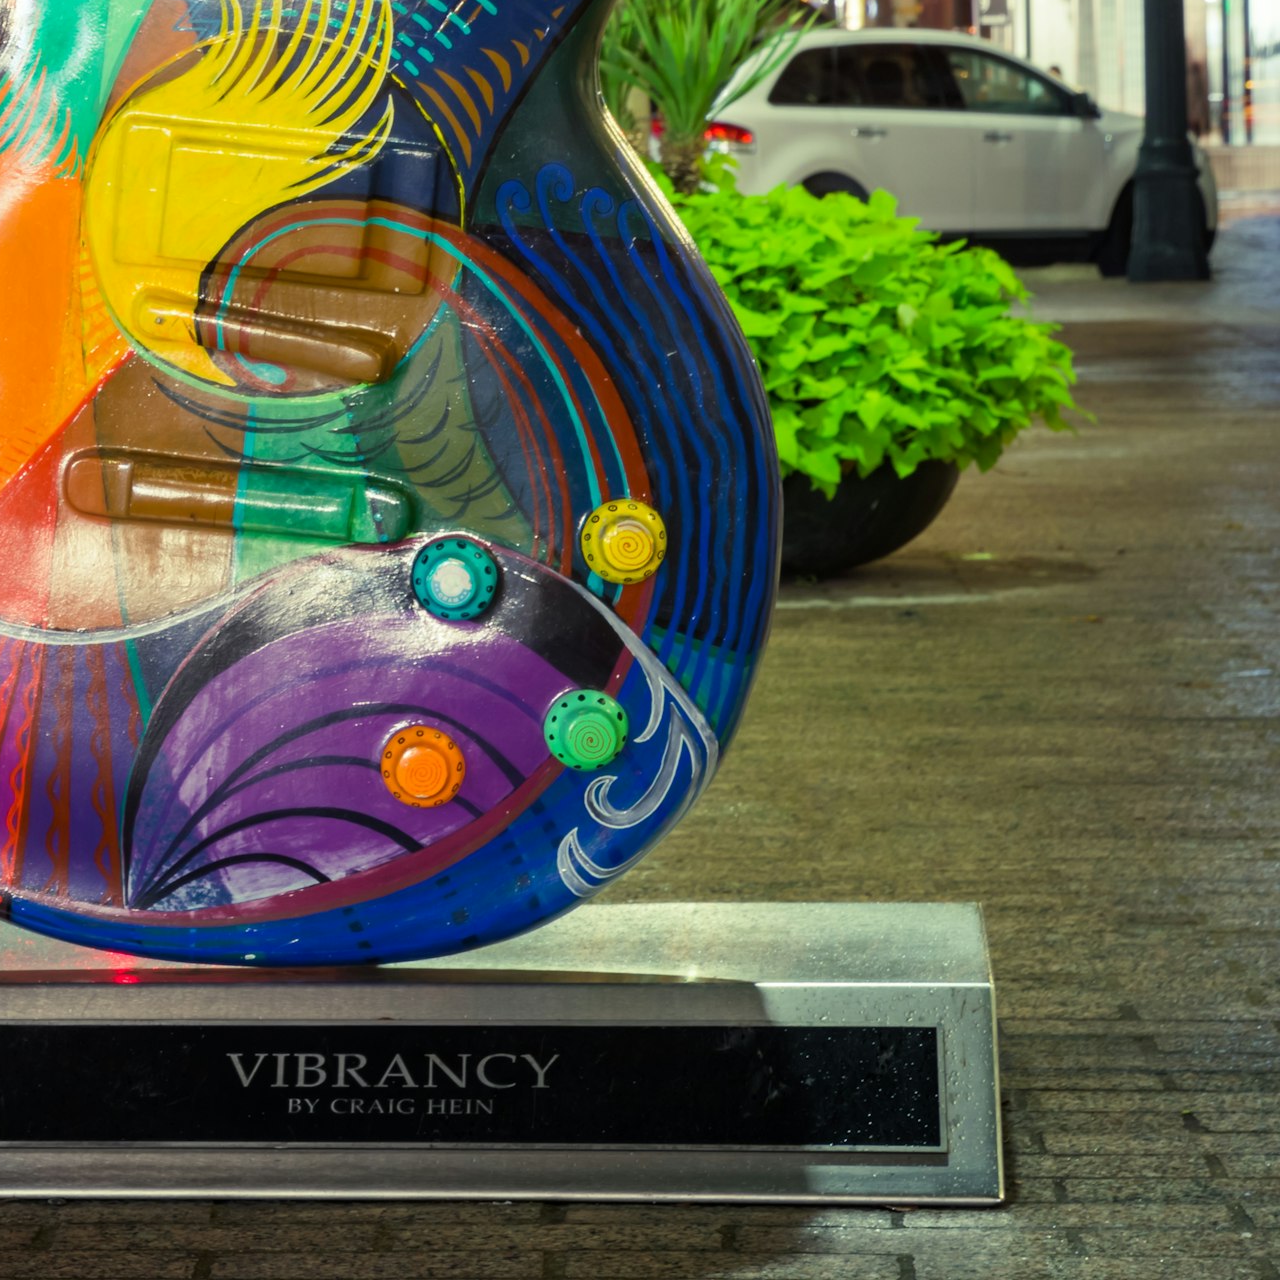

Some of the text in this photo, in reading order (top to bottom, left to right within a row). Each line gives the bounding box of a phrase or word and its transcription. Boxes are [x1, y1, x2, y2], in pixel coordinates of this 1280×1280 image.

[226, 1052, 560, 1089] VIBRANCY
[287, 1098, 494, 1115] BY CRAIG HEIN
